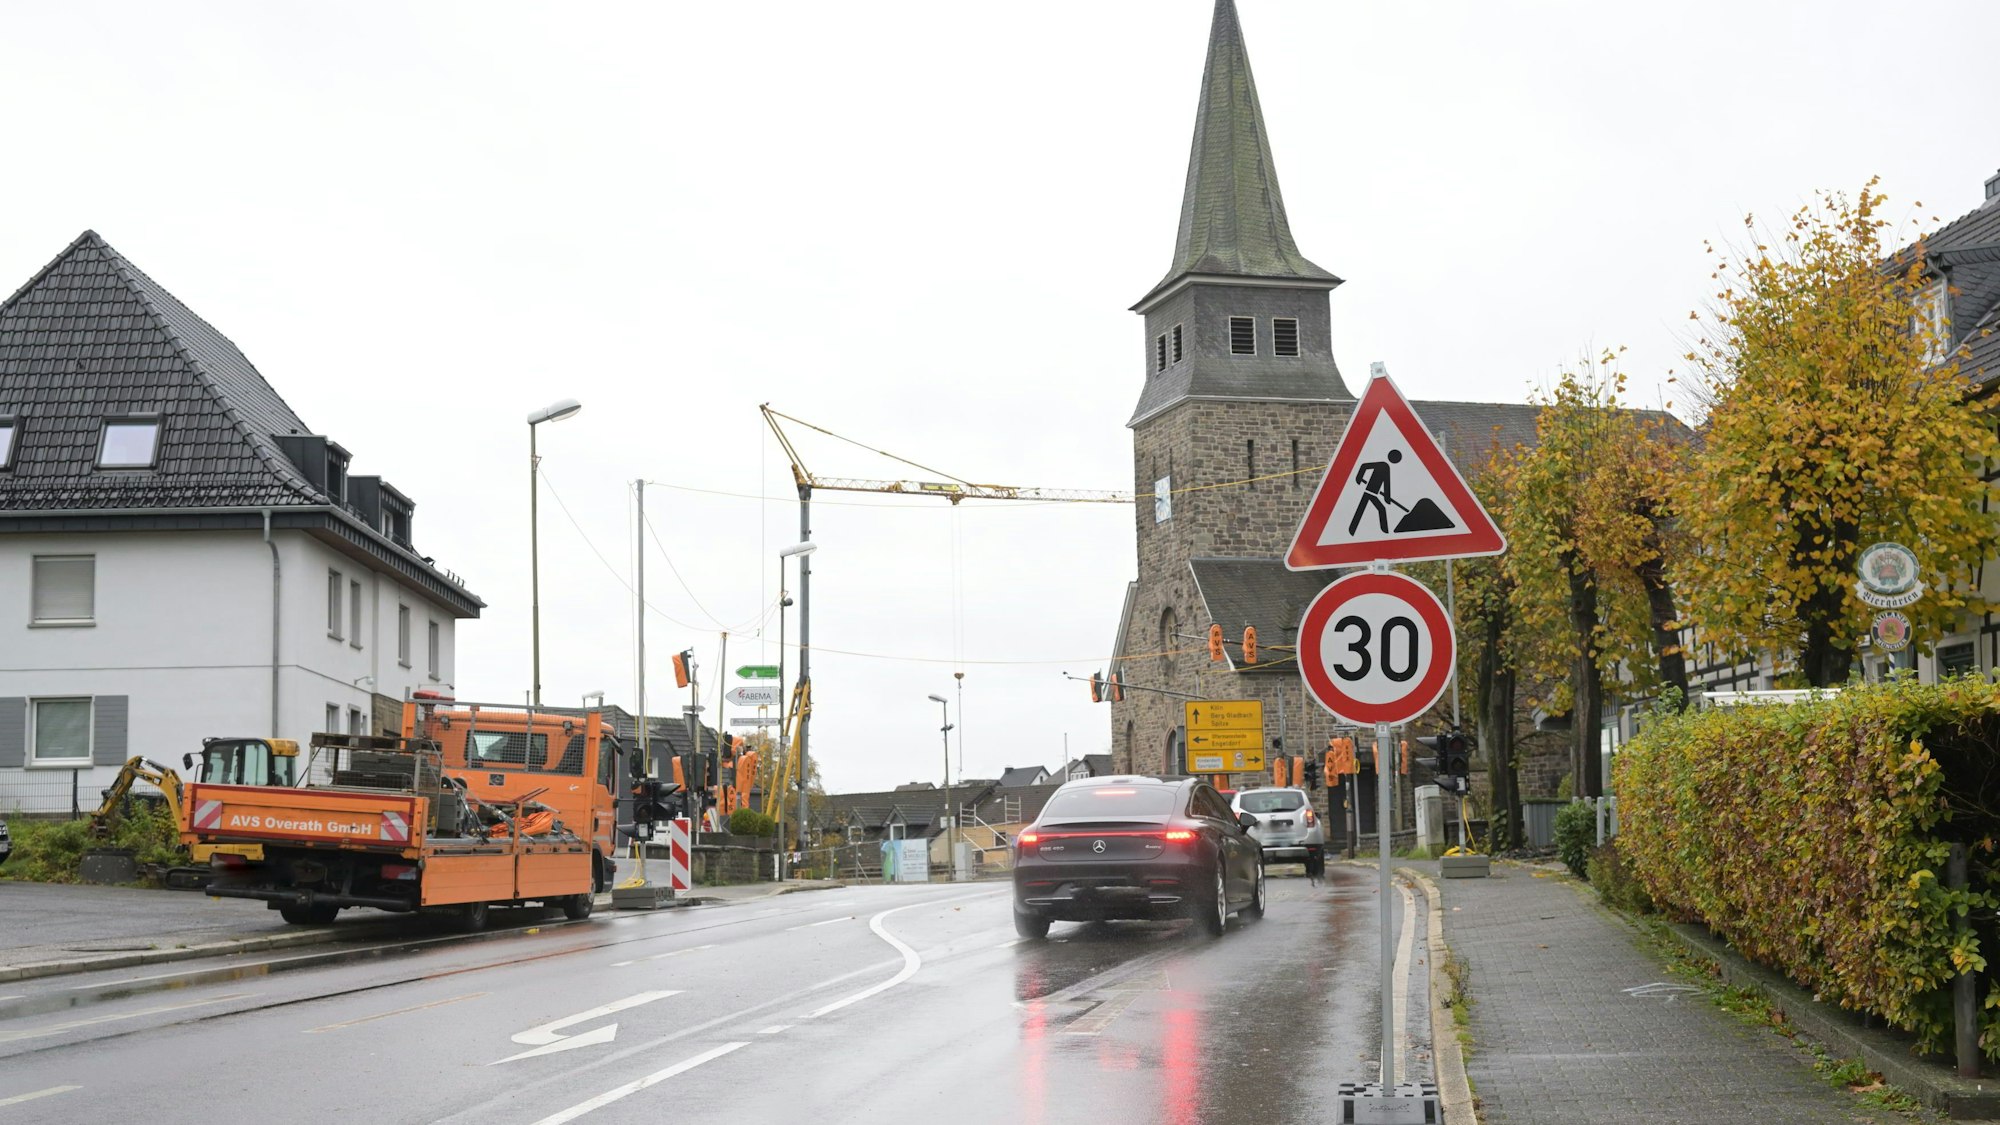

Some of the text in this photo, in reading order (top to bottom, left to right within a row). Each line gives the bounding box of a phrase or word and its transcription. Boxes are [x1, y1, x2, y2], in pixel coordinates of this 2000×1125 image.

[1863, 591, 1919, 609] Biergarten
[1333, 615, 1419, 682] 30
[741, 692, 772, 701] FABEMA
[230, 815, 373, 836] AVS Overath GmbH
